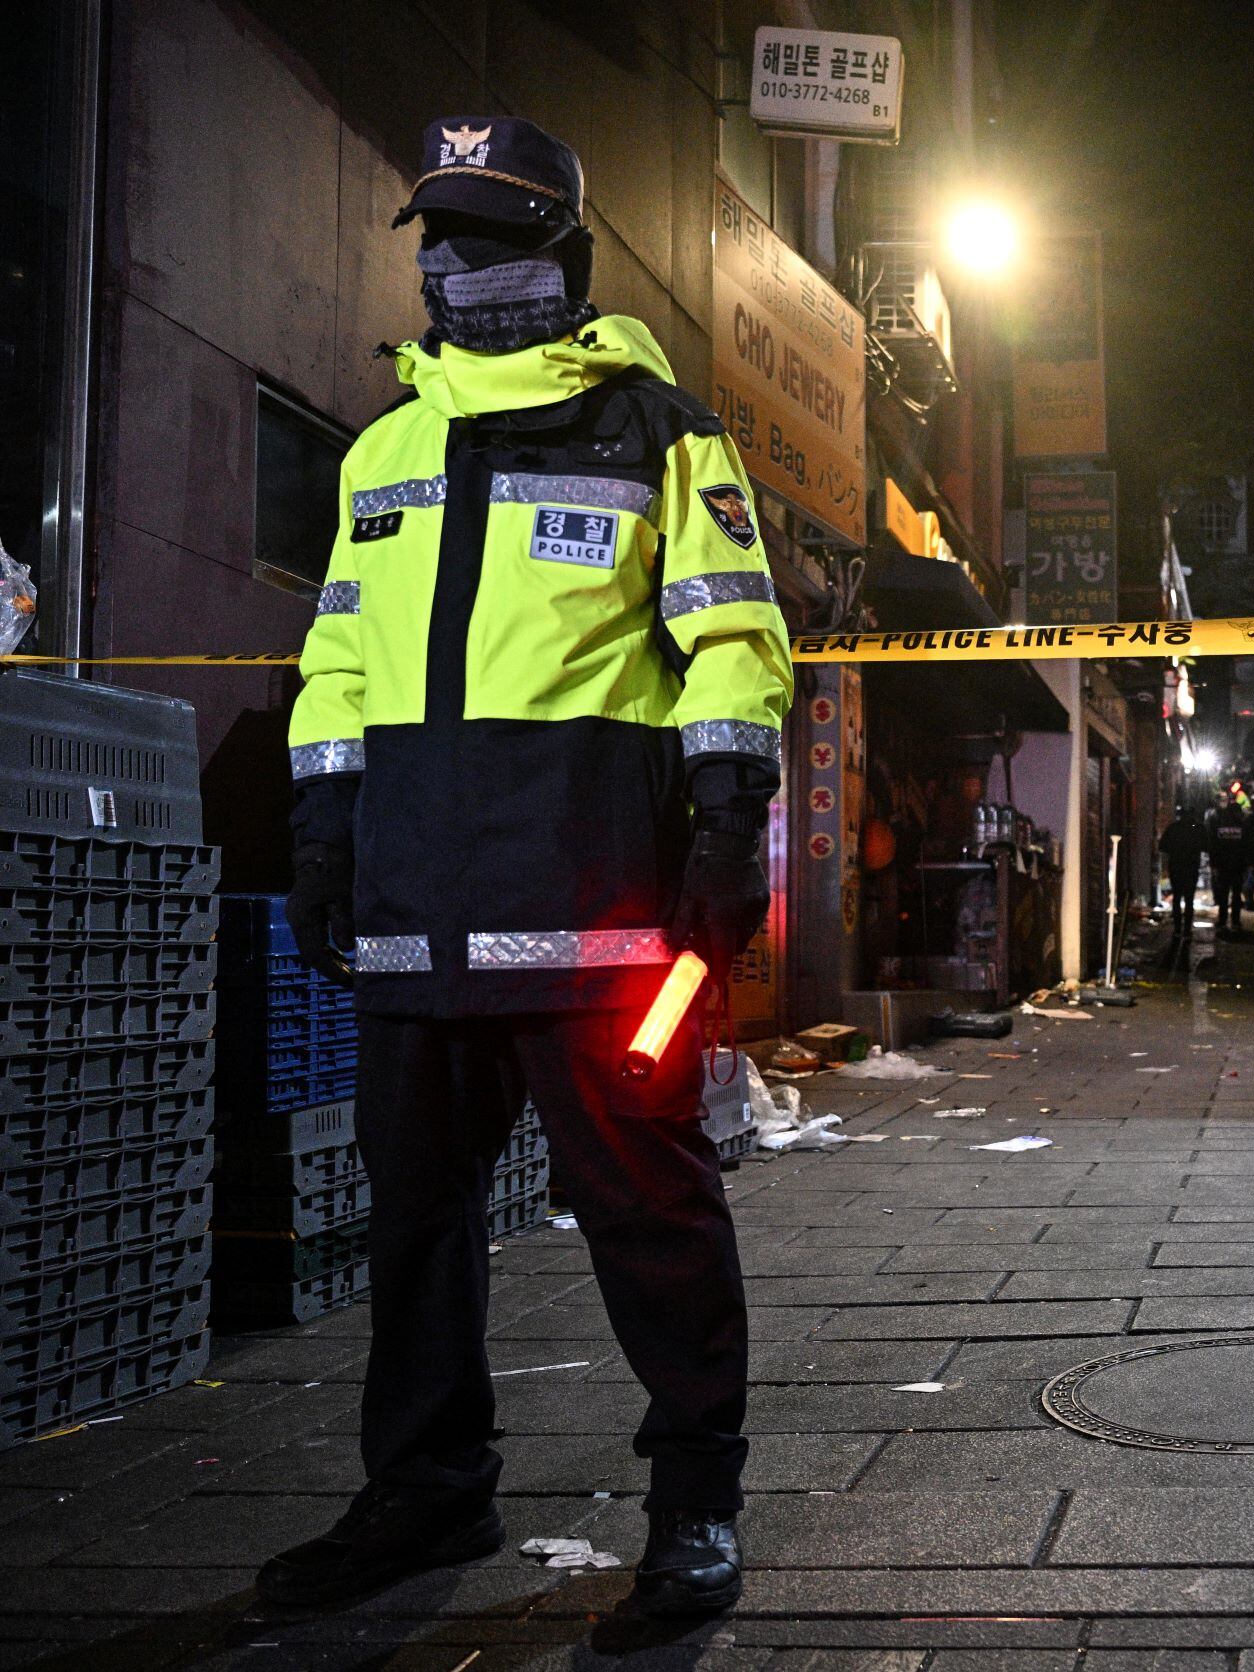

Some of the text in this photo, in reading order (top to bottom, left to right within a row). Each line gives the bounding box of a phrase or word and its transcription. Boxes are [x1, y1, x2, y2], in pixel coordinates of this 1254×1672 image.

[763, 42, 890, 84] 해밀톤 골프샵
[761, 81, 870, 104] 010-3772-4268
[872, 105, 888, 117] B1
[721, 193, 788, 288] 해밀톤
[734, 302, 846, 434] CHO JEWERY
[770, 421, 811, 490] Bag,
[543, 511, 608, 544] 경 찰
[537, 541, 606, 561] POLICE
[1031, 550, 1111, 583] 가방
[1005, 622, 1193, 648] LINE-수사중
